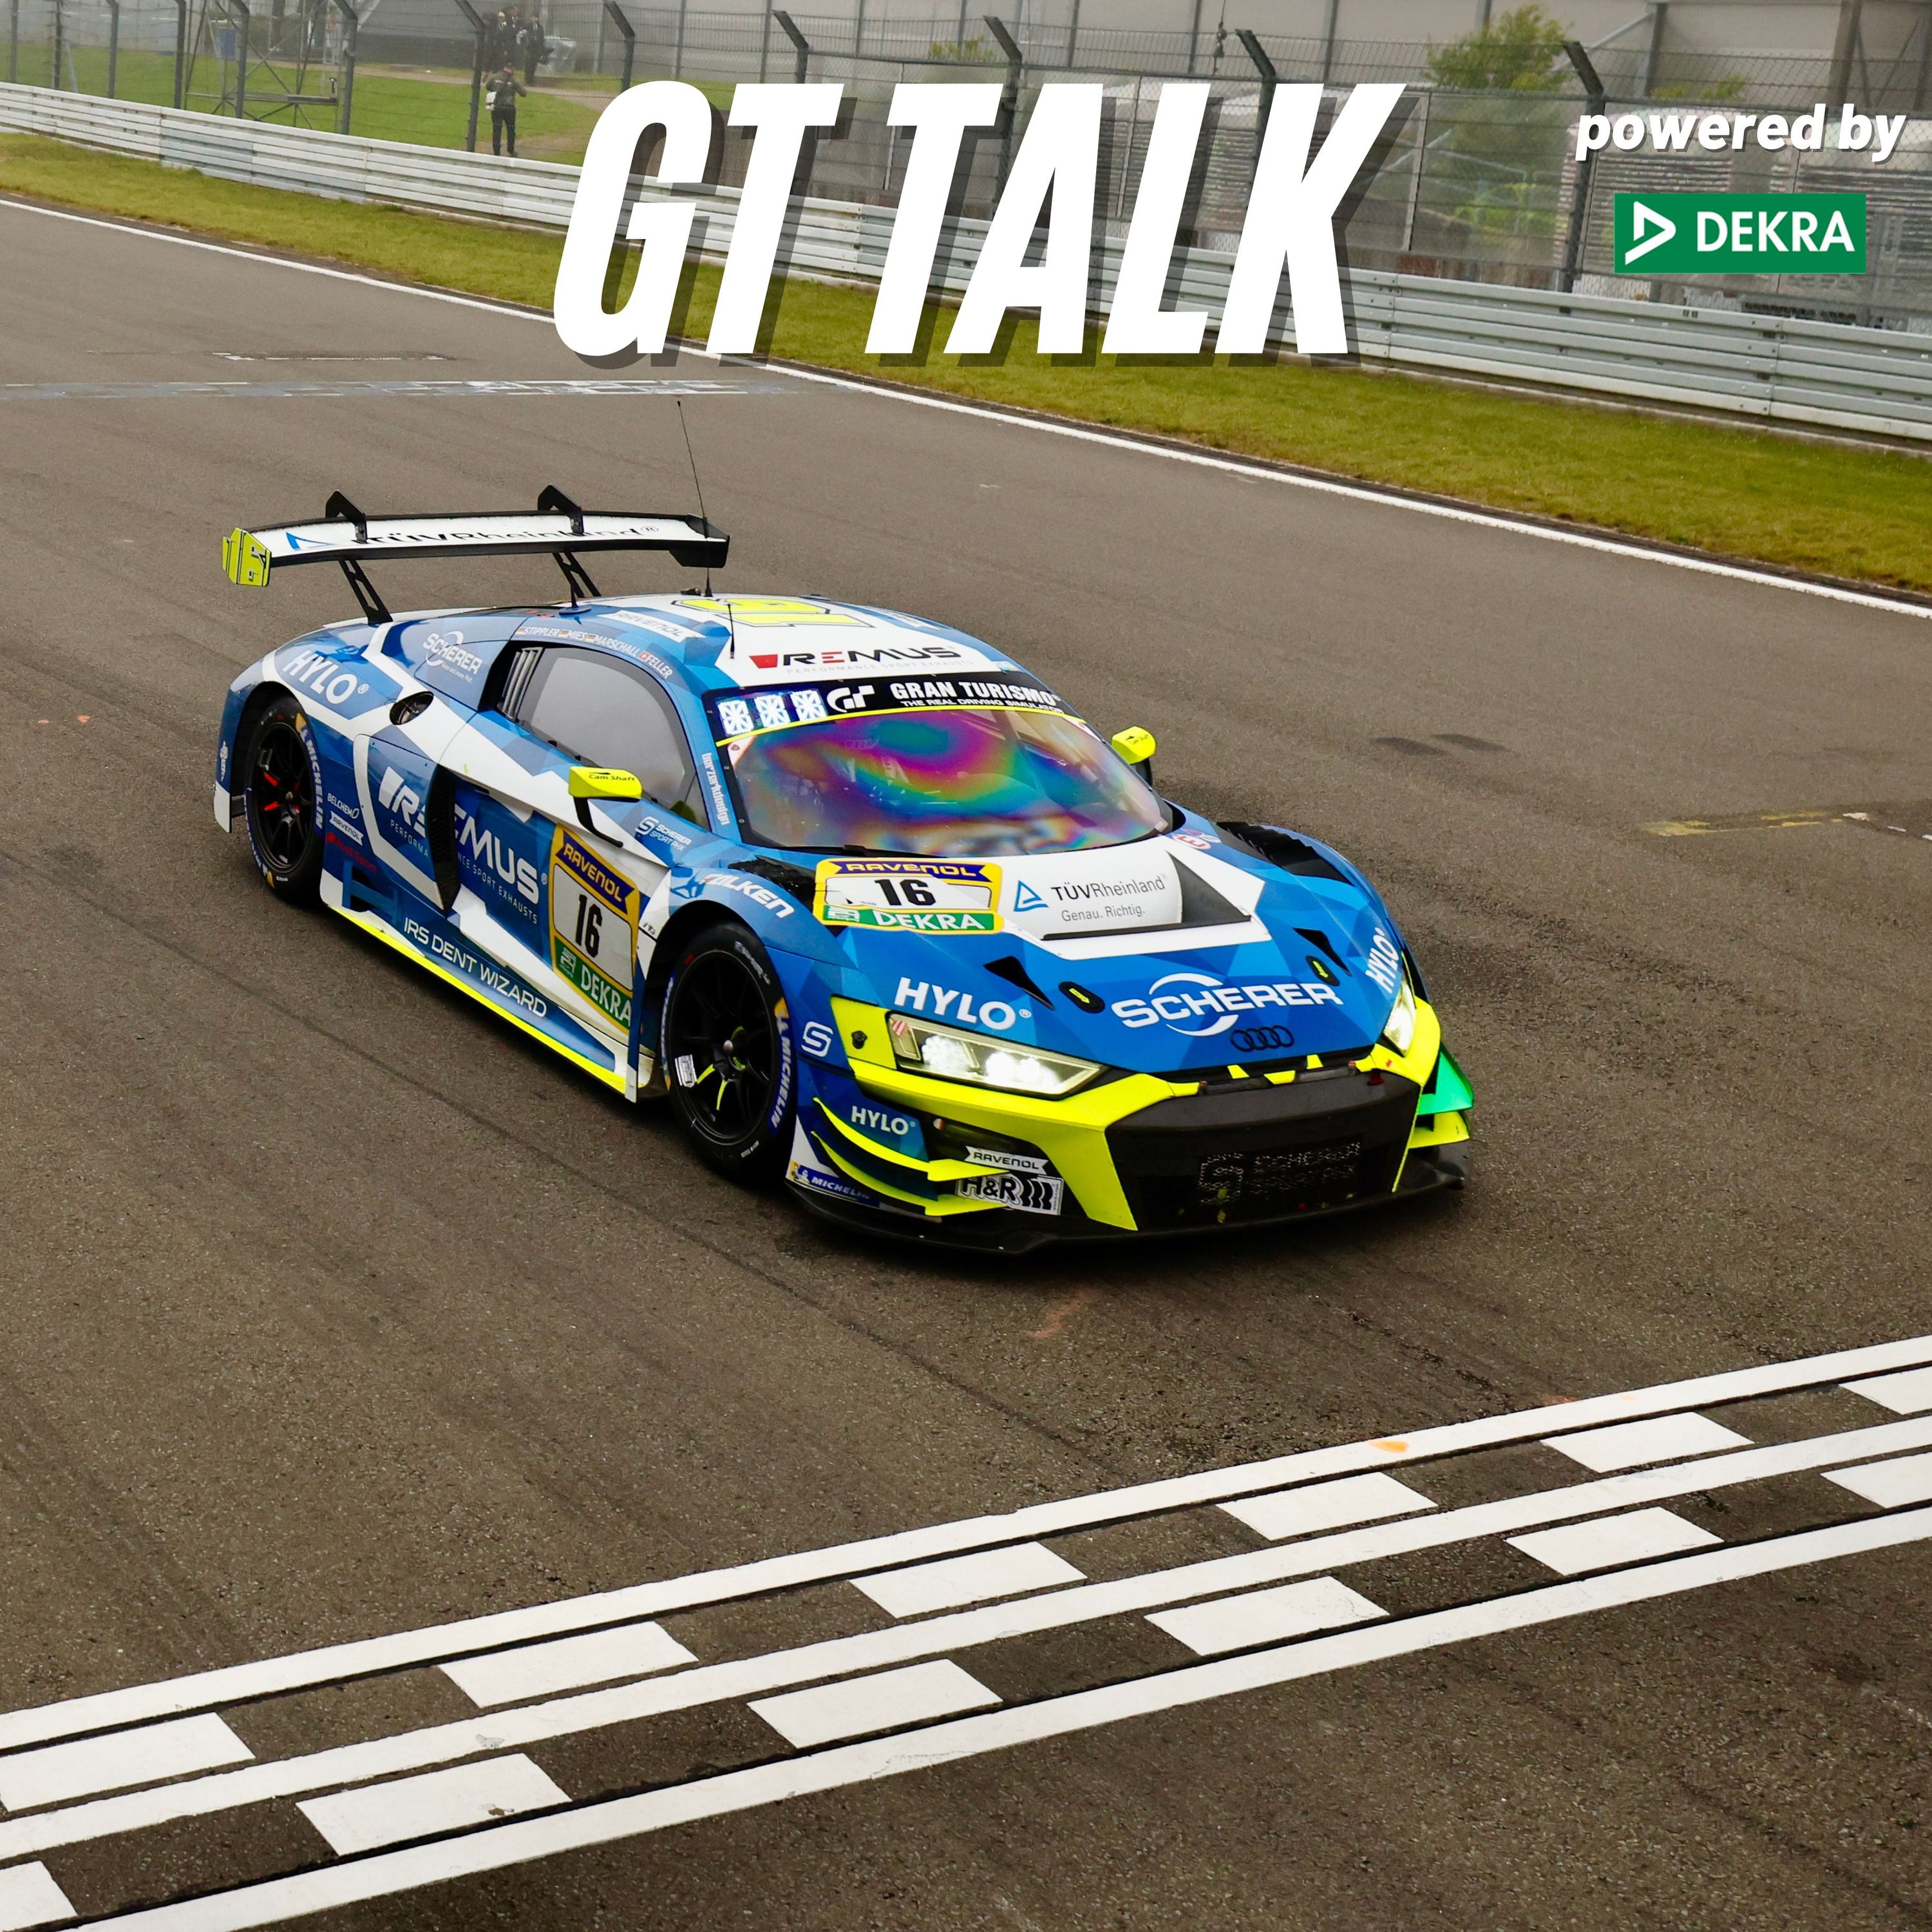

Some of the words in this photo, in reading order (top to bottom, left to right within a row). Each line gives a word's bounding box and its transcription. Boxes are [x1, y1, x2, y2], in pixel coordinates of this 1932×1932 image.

[524, 627, 560, 638] STIPPLER
[566, 630, 587, 640] MIES
[422, 633, 482, 675] SCHERER
[595, 635, 640, 657] MARSCHALL
[782, 647, 961, 667] REMUS
[647, 654, 673, 679] FELLER
[786, 664, 877, 674] PERFORMANCE
[881, 661, 917, 670] SPORT
[921, 659, 974, 668] EXHAUSTS
[889, 681, 958, 700] GRAN
[1005, 700, 1065, 714] SIMULATOR
[306, 739, 323, 829] MICHELIN
[333, 817, 360, 840] RAVENOL
[649, 830, 674, 844] SPORT
[656, 824, 692, 846] SCHERER
[564, 842, 623, 902] RAVENOL
[846, 863, 977, 876] RAVENOL
[473, 866, 496, 889] SPORT
[498, 886, 538, 925] EXHAUSTS
[698, 873, 795, 918] FALKEN
[875, 878, 936, 906] 16
[871, 910, 985, 930] DEKRA
[1061, 908, 1103, 922] Genau.
[1105, 904, 1146, 918] Richtig.
[576, 893, 603, 958] 16
[404, 917, 429, 945] IRS
[431, 936, 477, 973] DENT
[480, 963, 547, 1018] WIZARD
[580, 964, 631, 1027] DEKRA
[1111, 982, 1344, 1028] SCHERER
[771, 1035, 791, 1128] MICHELIN
[973, 1151, 1039, 1170] RAVENOL
[961, 1176, 1017, 1202] H&R
